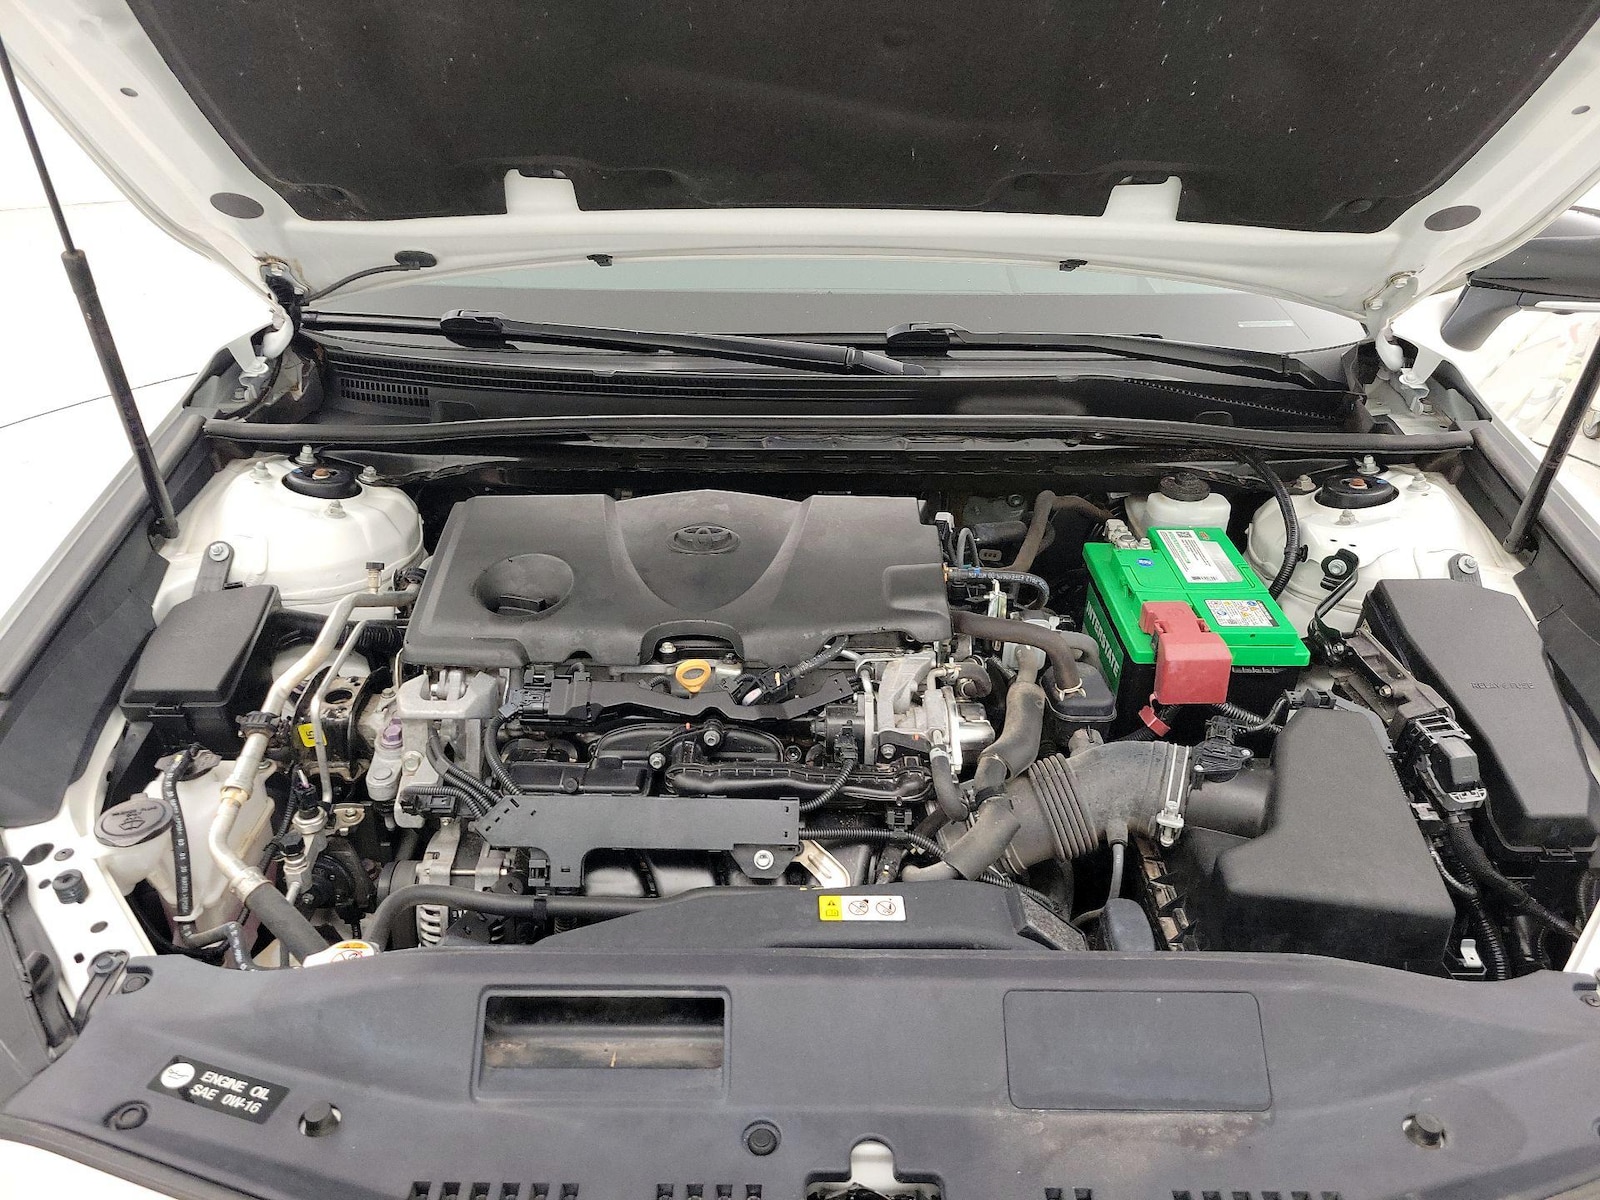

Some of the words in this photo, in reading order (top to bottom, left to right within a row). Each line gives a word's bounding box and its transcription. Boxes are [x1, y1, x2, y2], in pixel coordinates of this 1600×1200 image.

[1086, 600, 1120, 678] INTERSTATE
[189, 1084, 220, 1101] SAE
[221, 1093, 262, 1114] 0W-16
[200, 1071, 248, 1093] ENGINE
[249, 1085, 271, 1101] OIL
